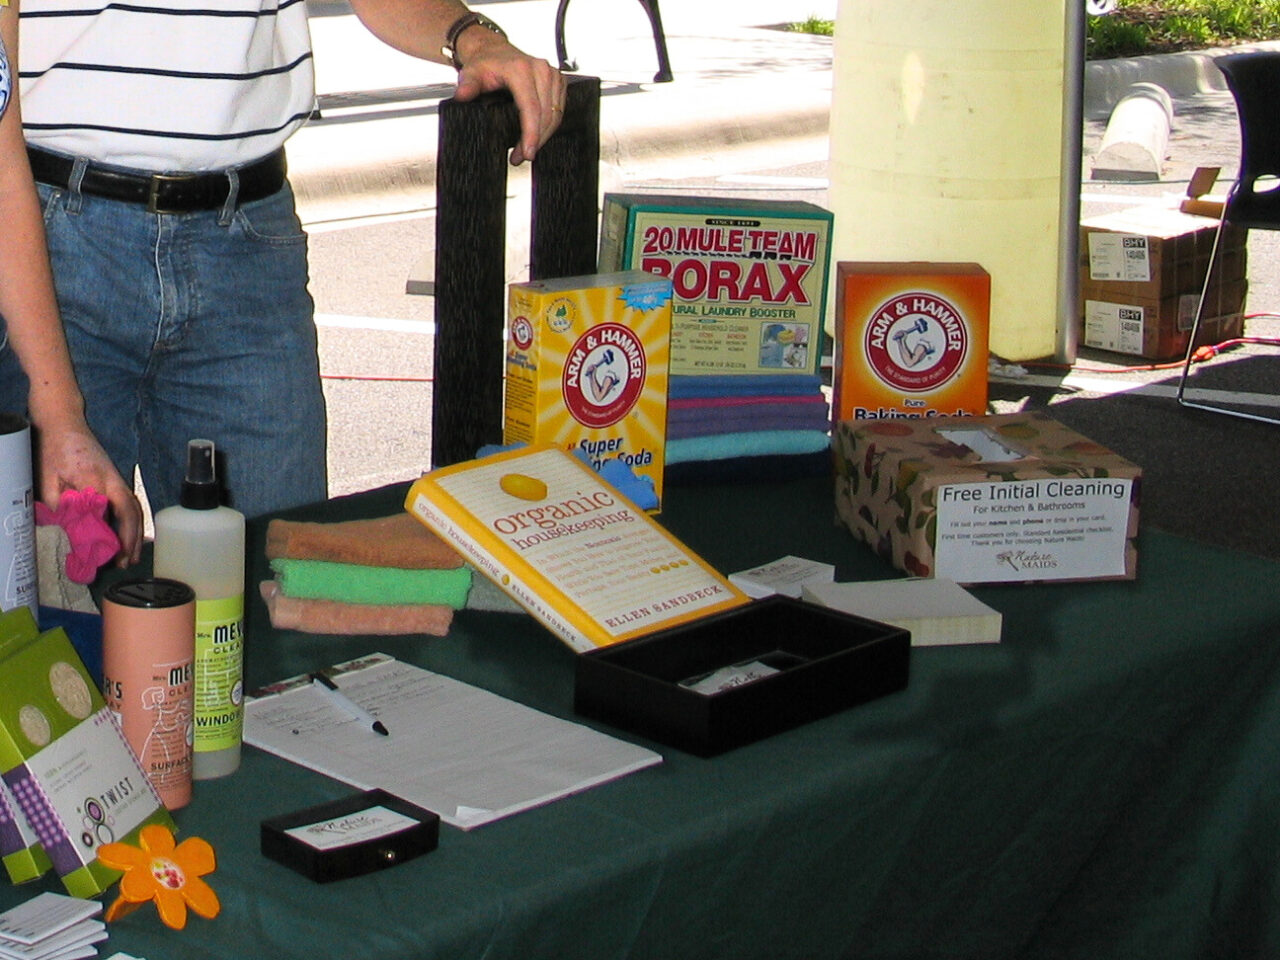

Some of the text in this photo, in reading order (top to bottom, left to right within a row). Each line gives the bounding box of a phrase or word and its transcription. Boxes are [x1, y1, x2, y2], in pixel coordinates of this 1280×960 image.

[643, 226, 816, 261] 20 MULE TEAM
[673, 305, 796, 319] URAL LAUNDRY BOOSTER
[871, 298, 961, 351] ARM & HAMMER
[567, 348, 586, 387] ARM
[586, 335, 597, 349] &
[600, 329, 642, 379] HAMMER
[904, 399, 926, 407] Pure
[580, 437, 624, 457] Super
[943, 480, 1125, 501] Free Initial Cleaning
[493, 489, 616, 535] organic
[973, 500, 1086, 514] For Kitchen & Bathrooms
[512, 508, 636, 551] housekeeping
[1023, 518, 1044, 526] phone
[447, 526, 501, 577] housekeeping
[1014, 550, 1052, 561] Nature
[1021, 560, 1058, 568] MAIDS
[511, 584, 536, 607] ELLEN
[604, 584, 723, 628] ELLEN SANDBECK
[100, 777, 134, 809] TWIST
